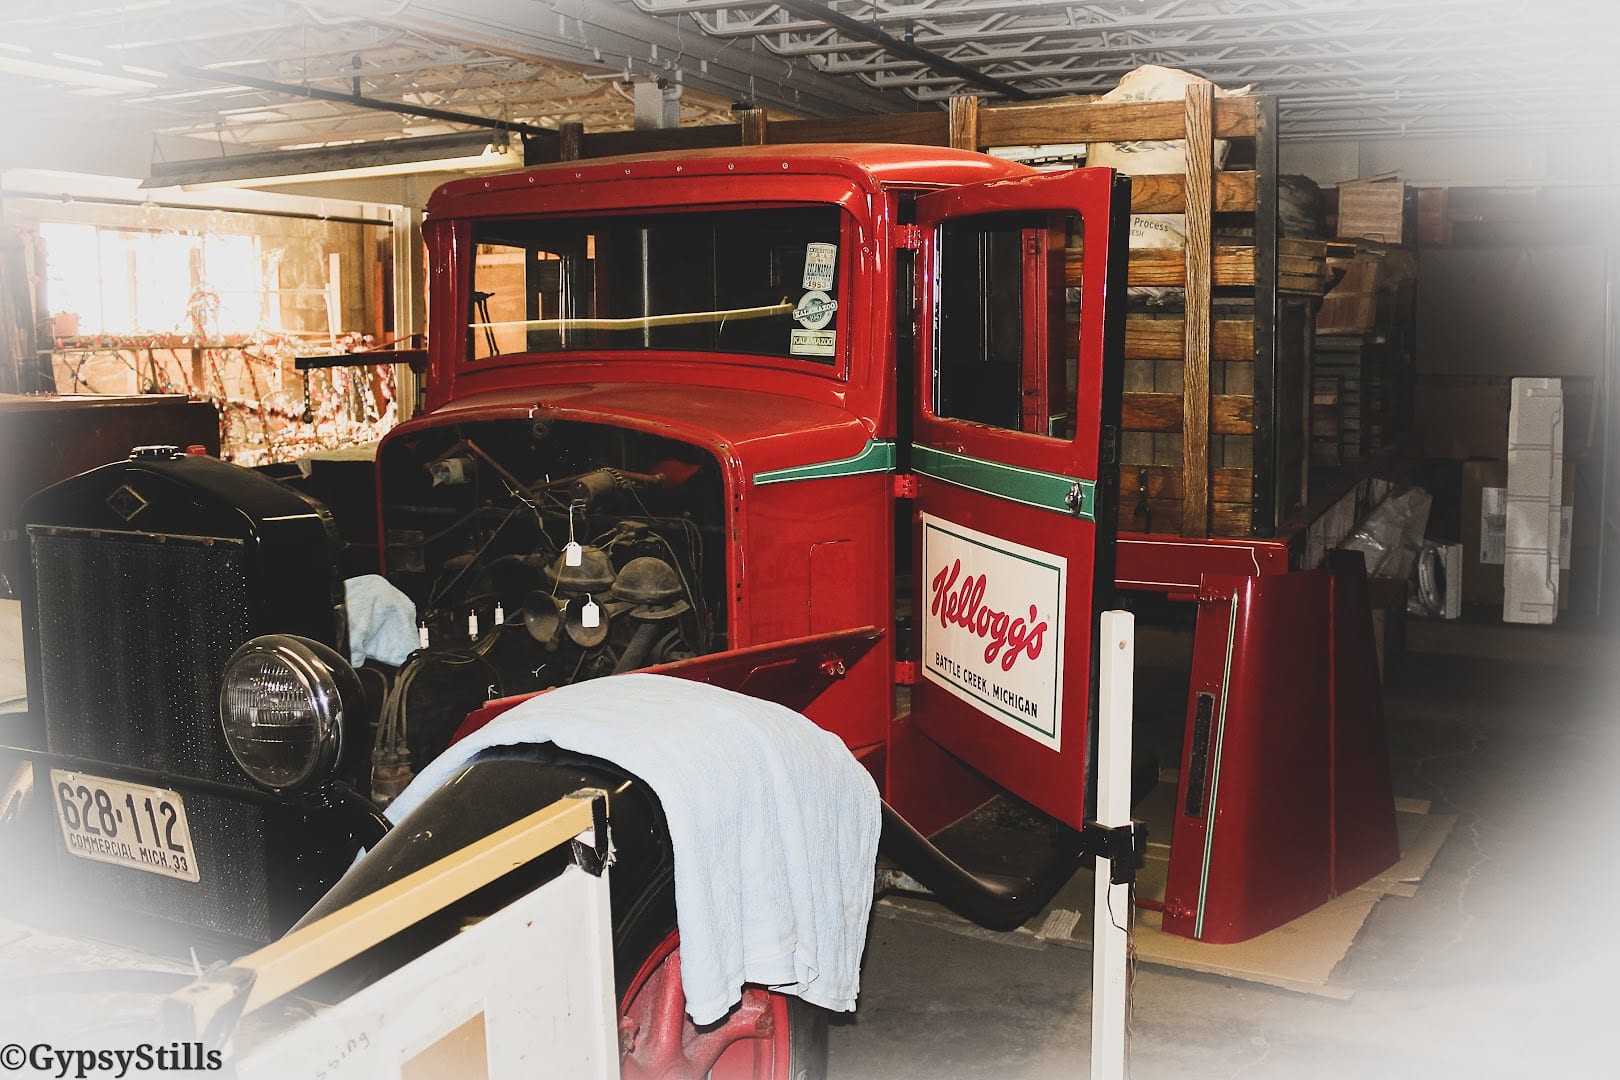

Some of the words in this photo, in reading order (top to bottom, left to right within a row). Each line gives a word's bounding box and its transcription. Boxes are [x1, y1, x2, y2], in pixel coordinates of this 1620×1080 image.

[1134, 217, 1169, 232] Process
[793, 335, 833, 347] KALAMAZOO
[931, 558, 1048, 672] Kellogg's
[935, 652, 961, 679] BATTLE
[992, 683, 1038, 718] MICHIGAN
[70, 833, 136, 860] COMMERCIAL
